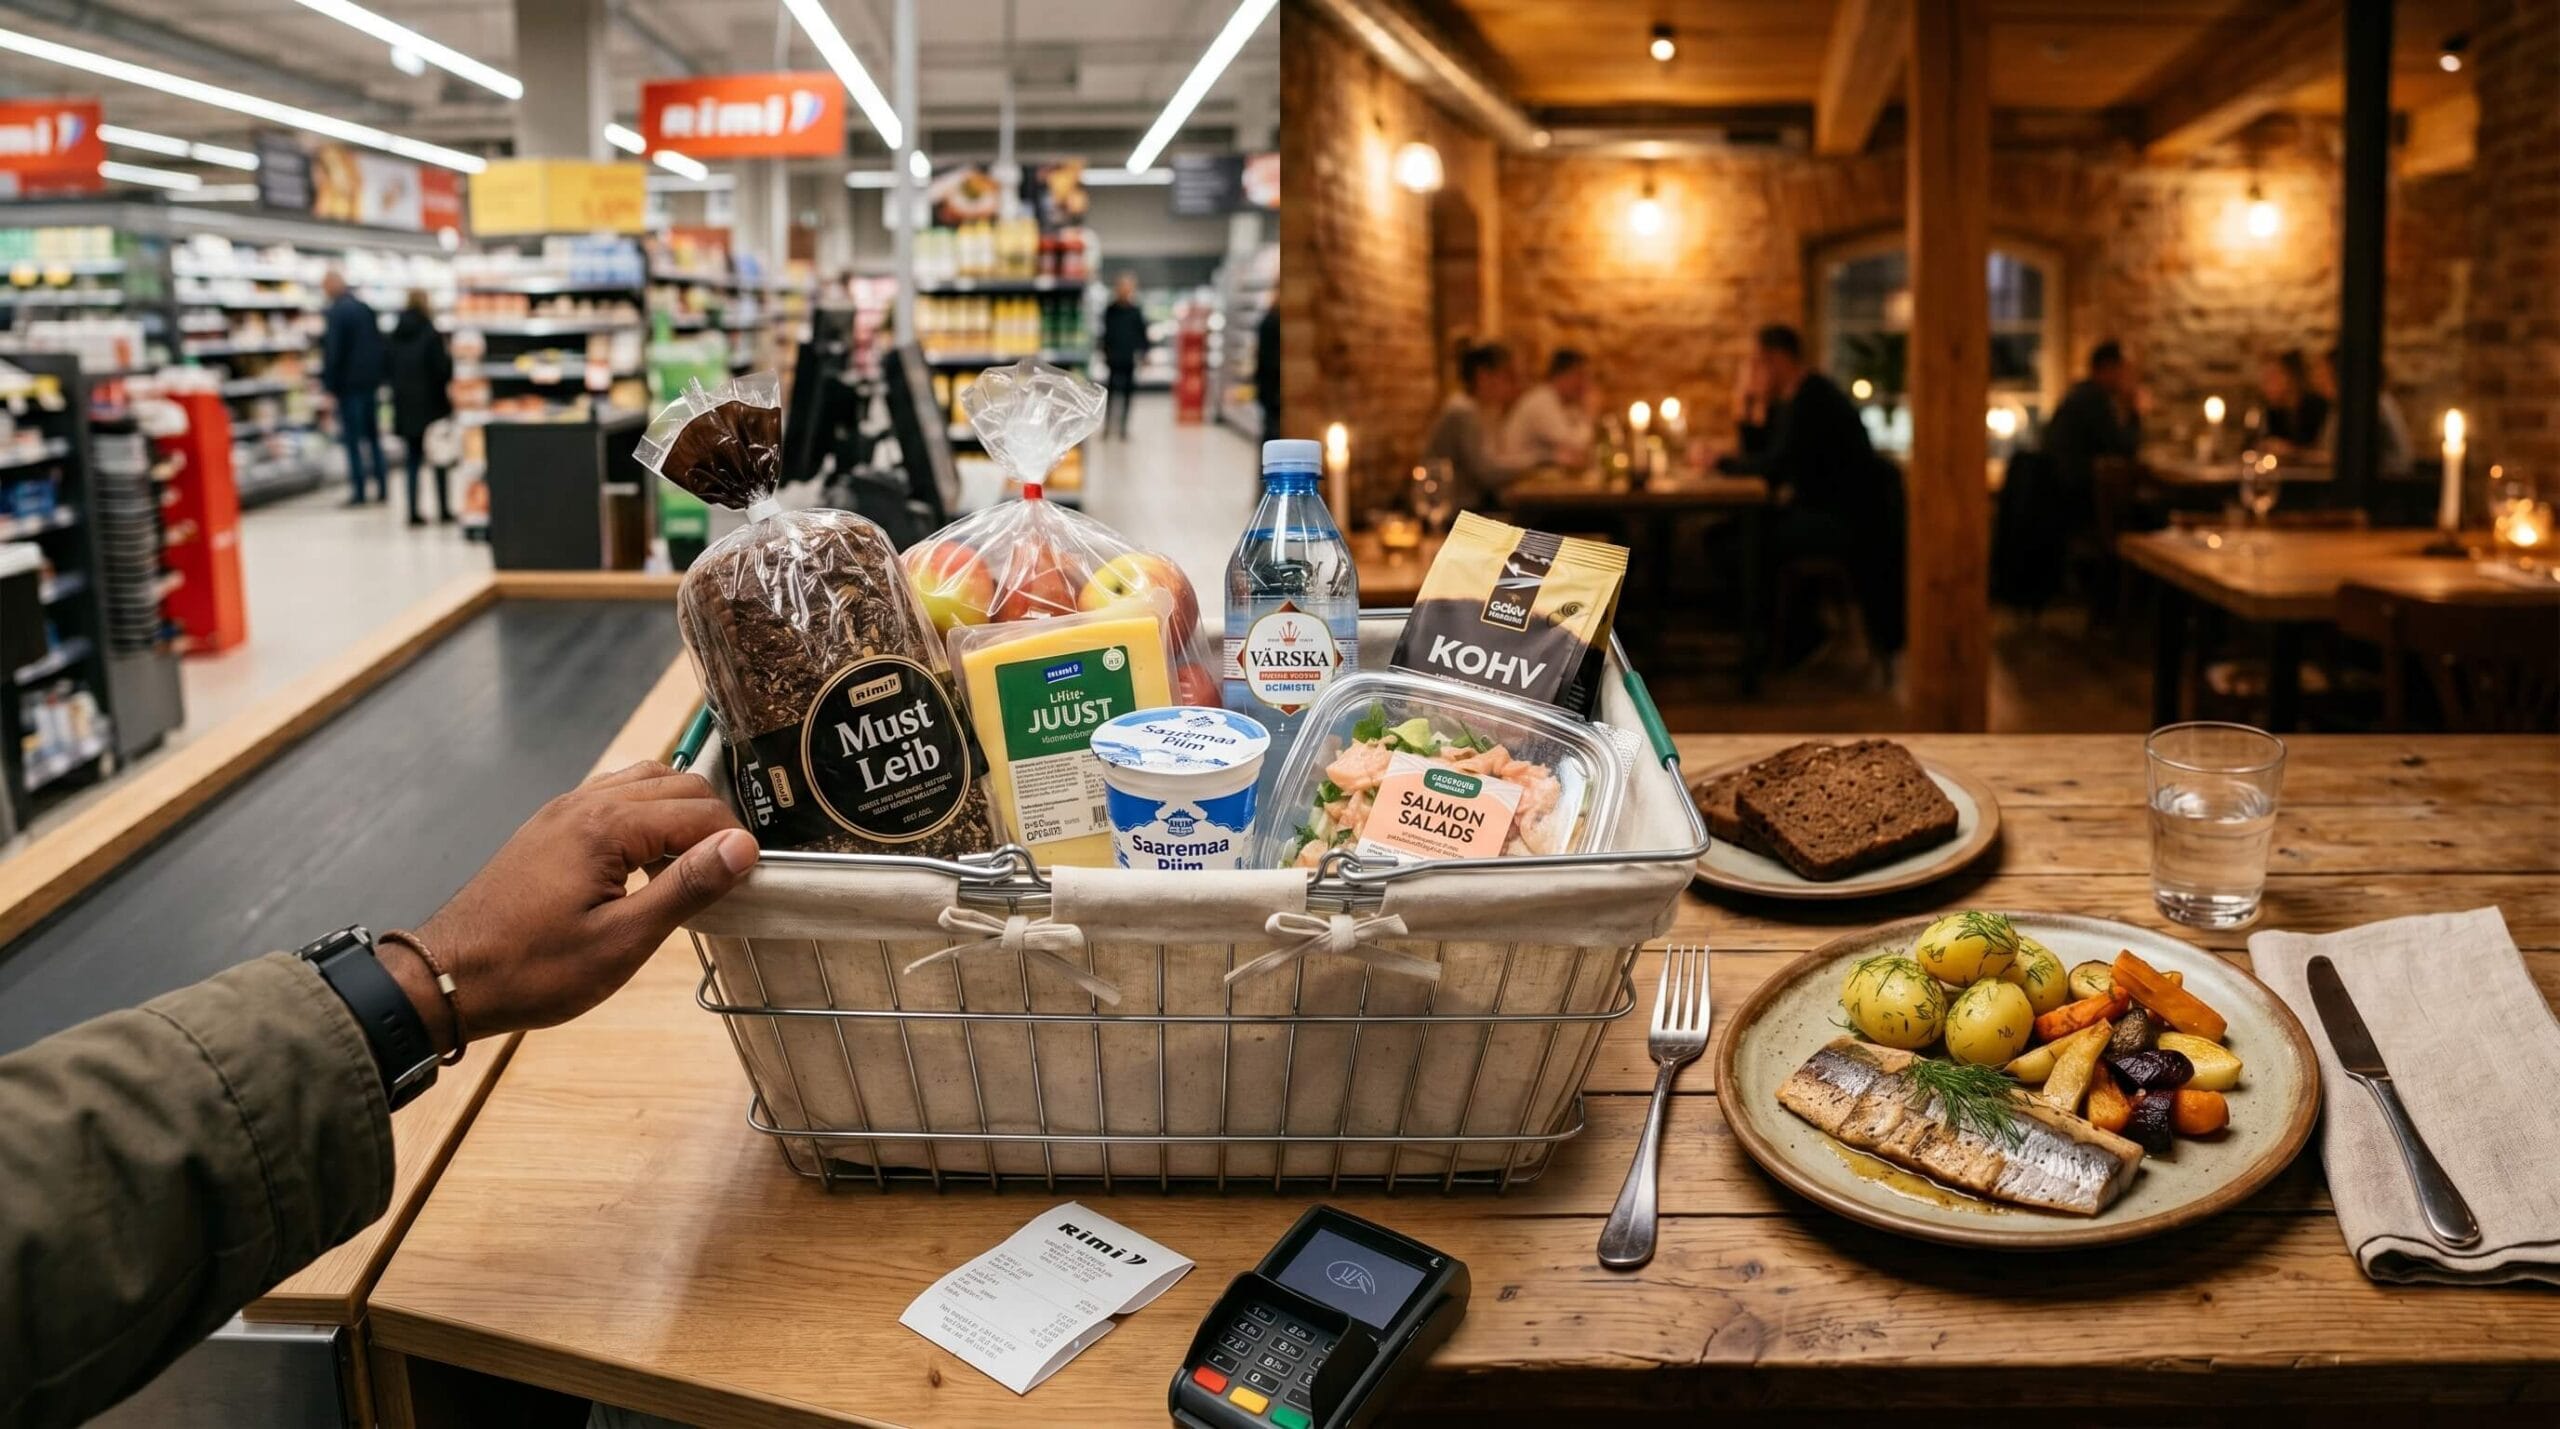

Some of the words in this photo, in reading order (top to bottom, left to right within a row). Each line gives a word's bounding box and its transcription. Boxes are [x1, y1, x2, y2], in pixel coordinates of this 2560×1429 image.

[1250, 647, 1331, 667] VÄRSKA
[1427, 634, 1547, 690] KOHV
[834, 699, 934, 758] Must
[1028, 697, 1113, 734] JUUST
[856, 737, 940, 793] Leib
[747, 760, 774, 826] Leib
[1400, 790, 1486, 828] SALMON
[1398, 809, 1475, 843] SALADS
[1132, 834, 1230, 857] Saaremaa
[1058, 1222, 1128, 1259] Rimi
